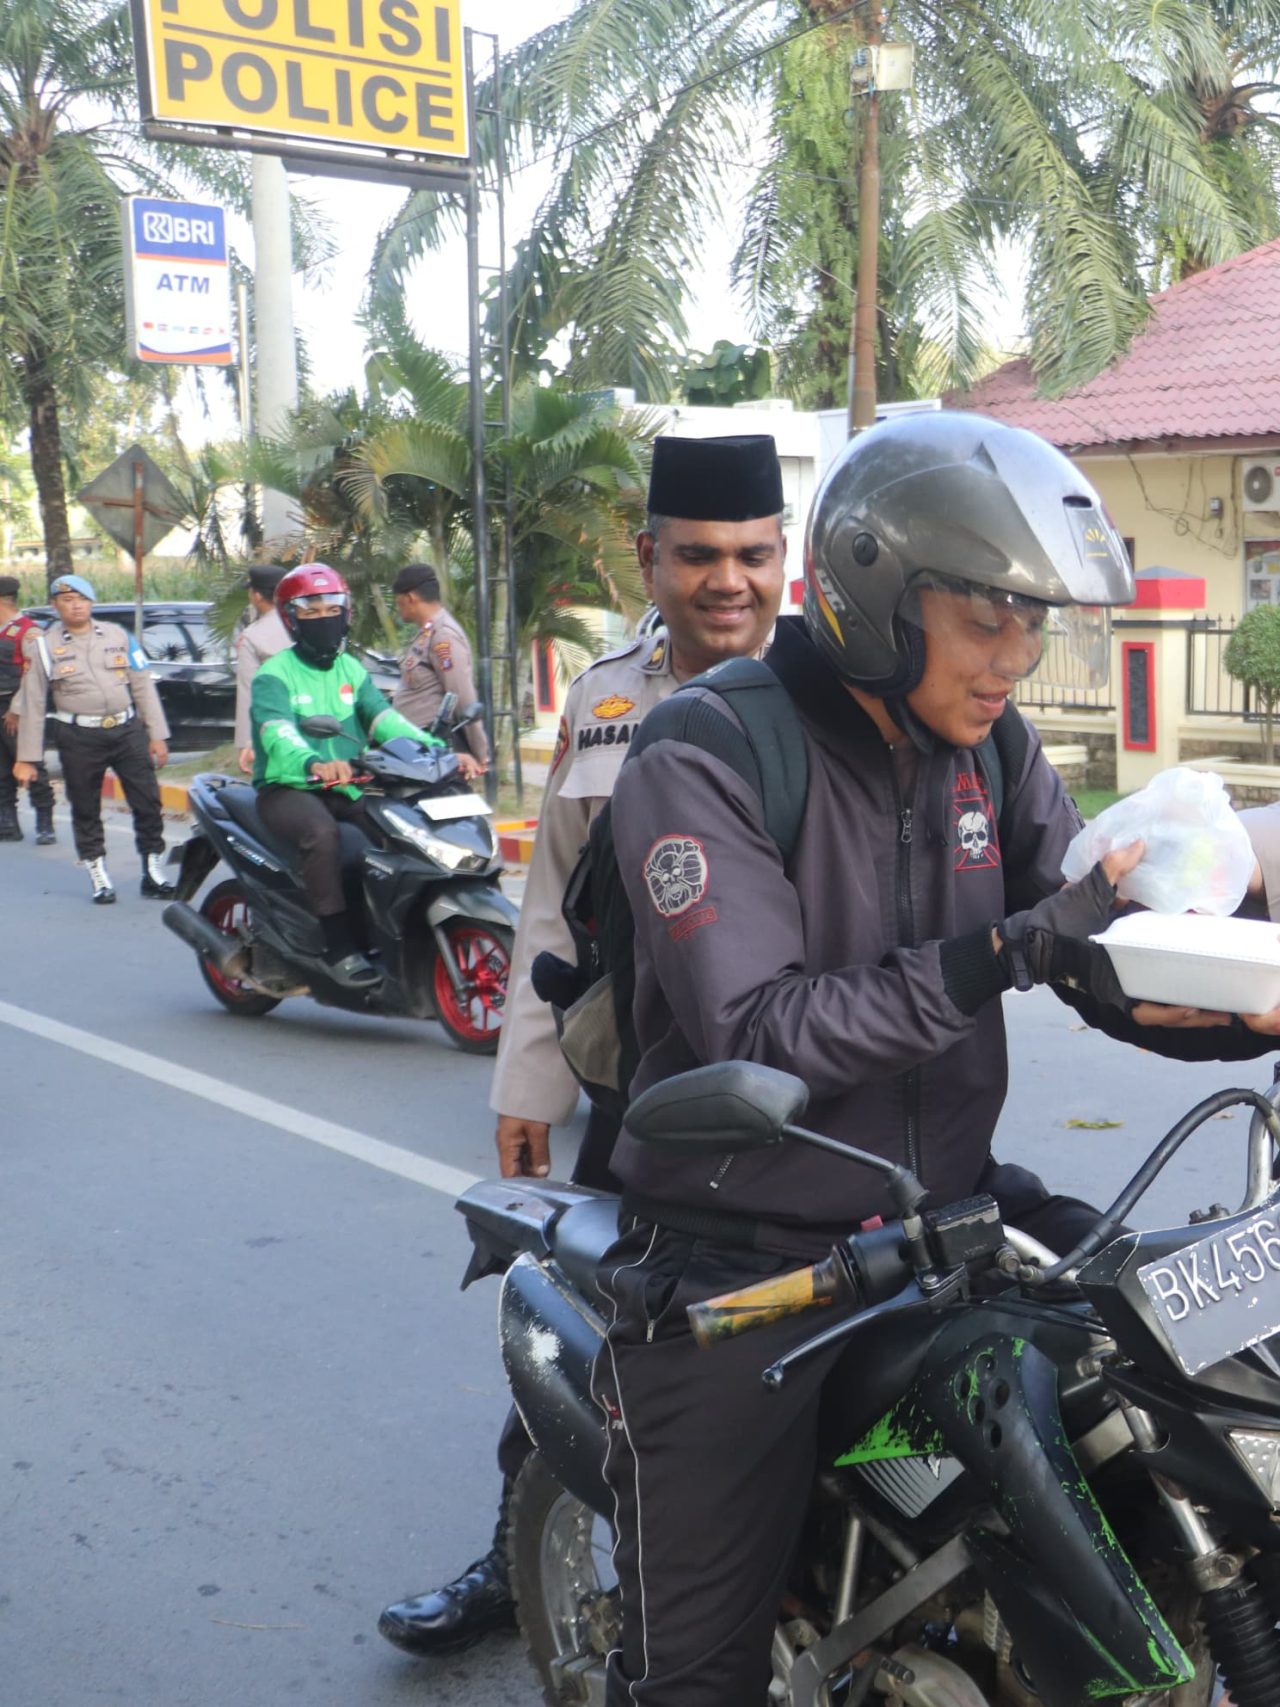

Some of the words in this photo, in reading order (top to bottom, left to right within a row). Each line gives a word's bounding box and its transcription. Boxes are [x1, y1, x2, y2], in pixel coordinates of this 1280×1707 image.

[160, 0, 452, 63] OLISI
[163, 38, 455, 142] POLICE
[174, 216, 215, 246] BRI
[156, 272, 211, 294] ATM
